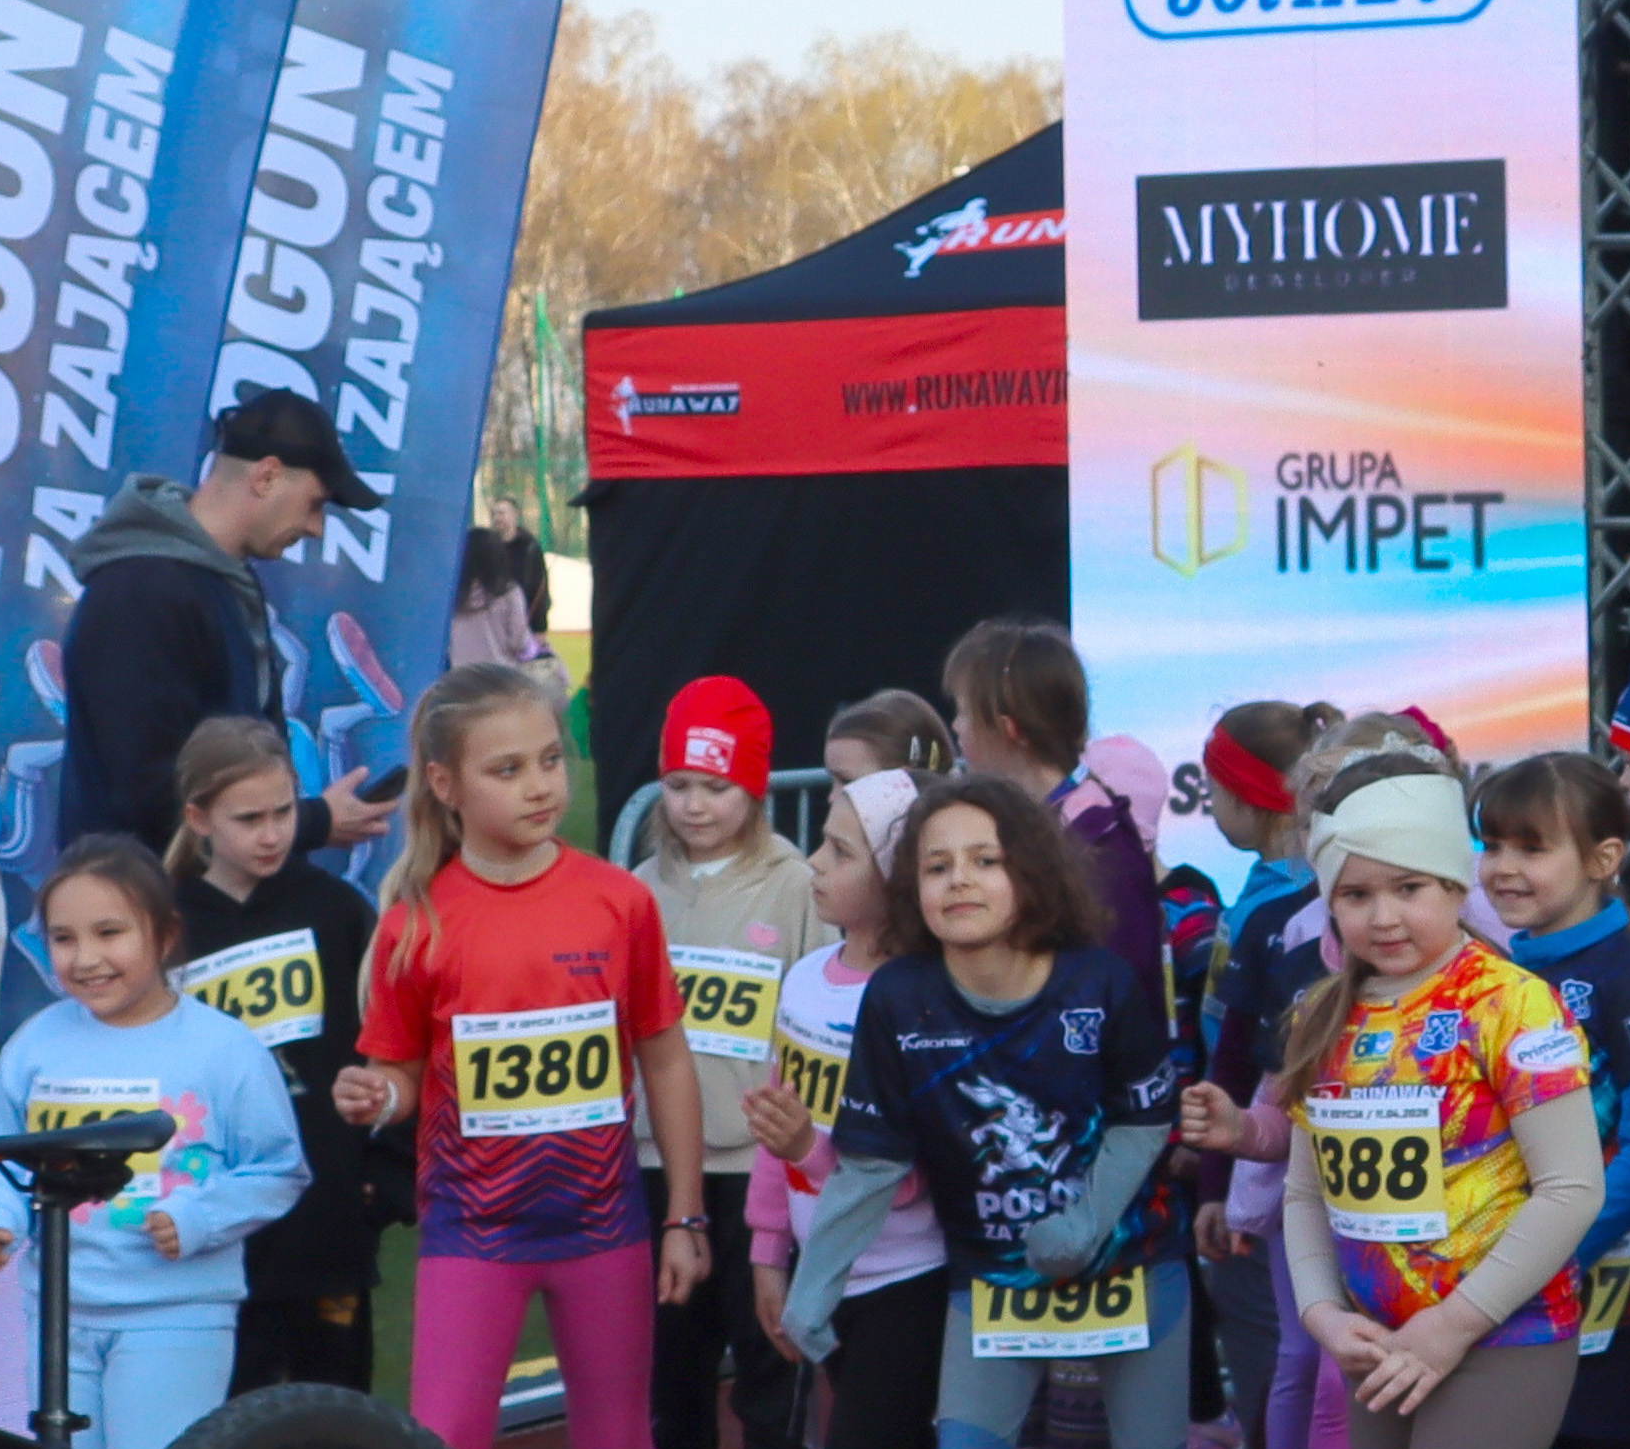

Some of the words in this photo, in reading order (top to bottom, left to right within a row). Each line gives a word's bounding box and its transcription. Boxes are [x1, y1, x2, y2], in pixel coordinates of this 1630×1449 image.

[40, 25, 174, 472] ZAJĄCEM
[337, 49, 454, 456] ZAJĄCEM
[1162, 191, 1484, 268] MYHOME
[1276, 451, 1402, 491] GRUPA
[1276, 492, 1505, 574] IMPET
[469, 1033, 611, 1100] 1380
